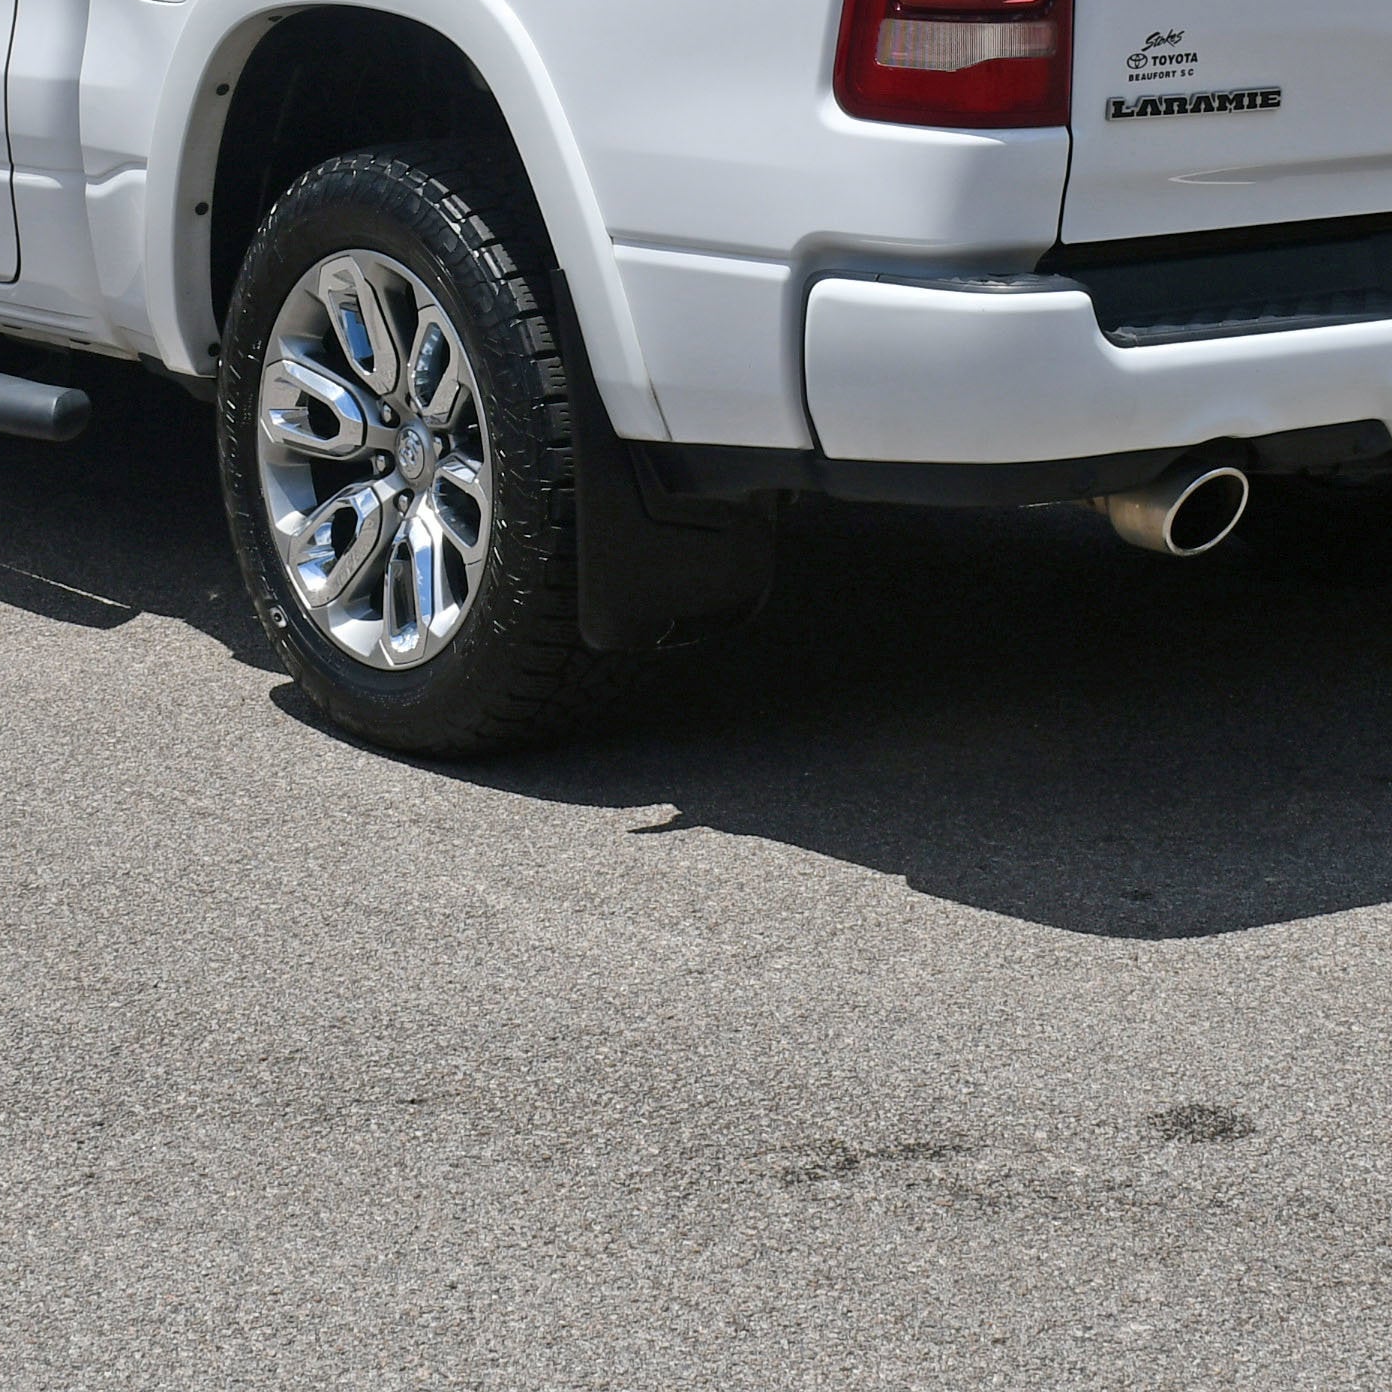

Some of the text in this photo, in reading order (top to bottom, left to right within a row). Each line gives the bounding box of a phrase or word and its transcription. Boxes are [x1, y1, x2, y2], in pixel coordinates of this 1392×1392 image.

[1141, 29, 1185, 52] Stokes
[1151, 52, 1198, 67] TOYOTA
[1128, 70, 1176, 82] BEAUFORT
[1108, 88, 1282, 120] LARAMIE
